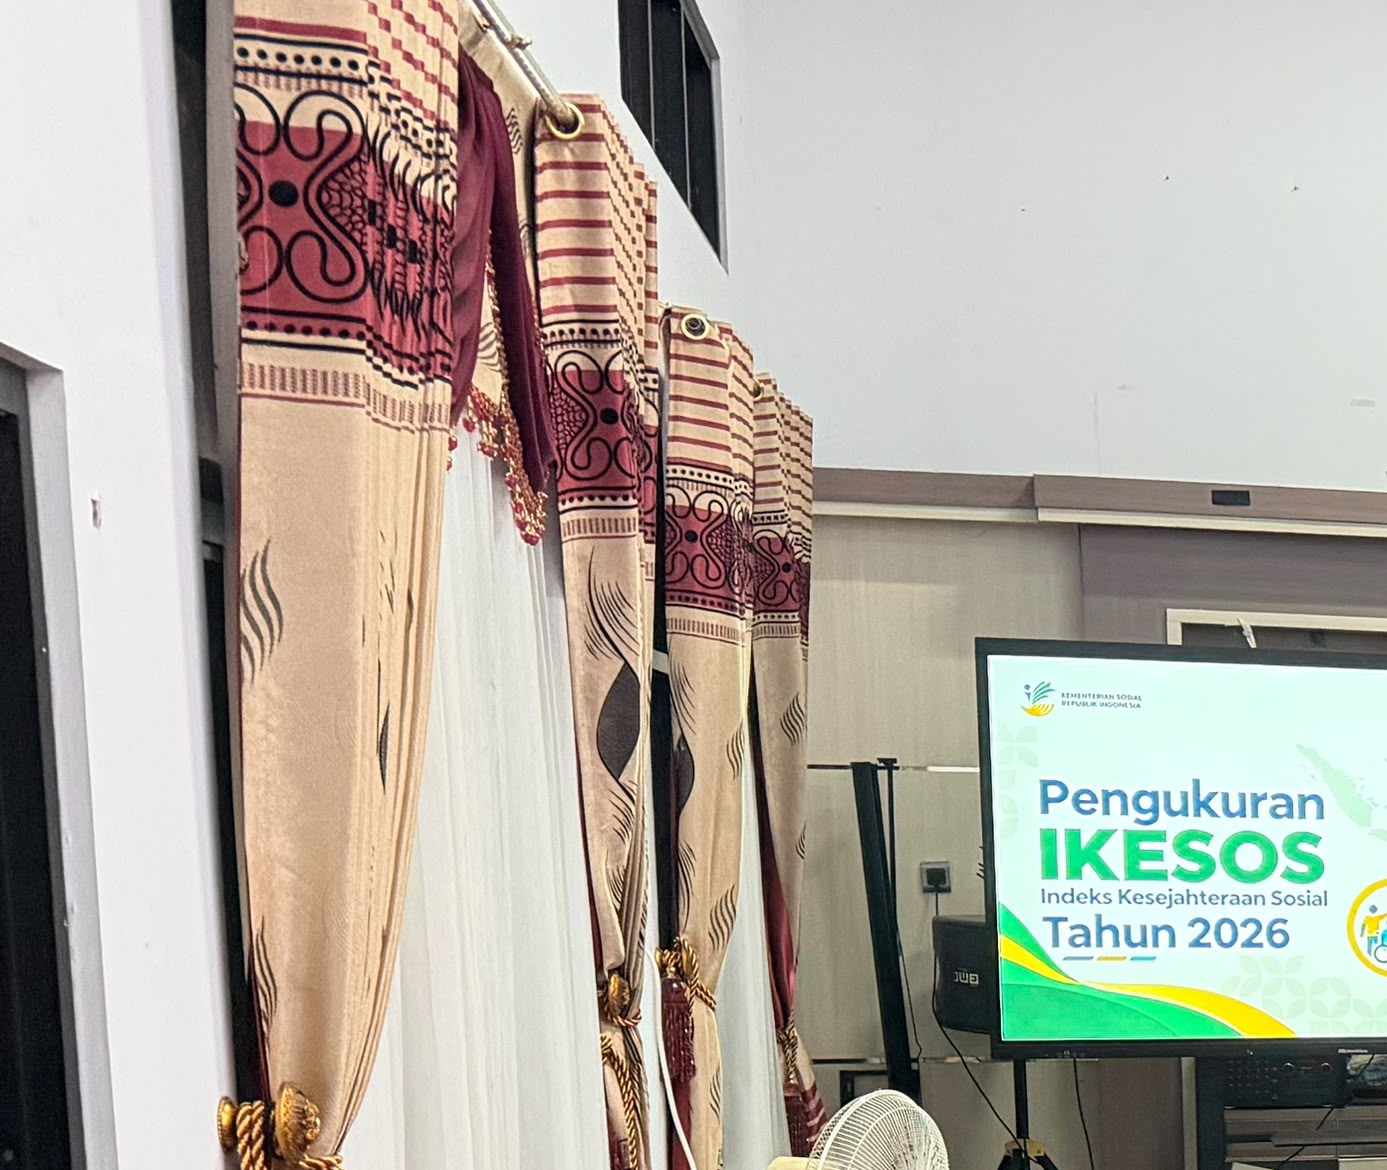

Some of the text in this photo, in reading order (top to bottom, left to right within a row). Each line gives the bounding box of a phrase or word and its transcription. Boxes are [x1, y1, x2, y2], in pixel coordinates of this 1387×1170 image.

[1061, 692, 1142, 702] KEMENTERIAN SOSIAL
[1061, 700, 1097, 708] REPUBLIK
[1040, 778, 1325, 826] Pengukuran
[1040, 828, 1325, 884] IKESOS
[1041, 887, 1328, 909] Indeks Kesejahteraan Sosial
[1042, 913, 1290, 949] Tahun 2026
